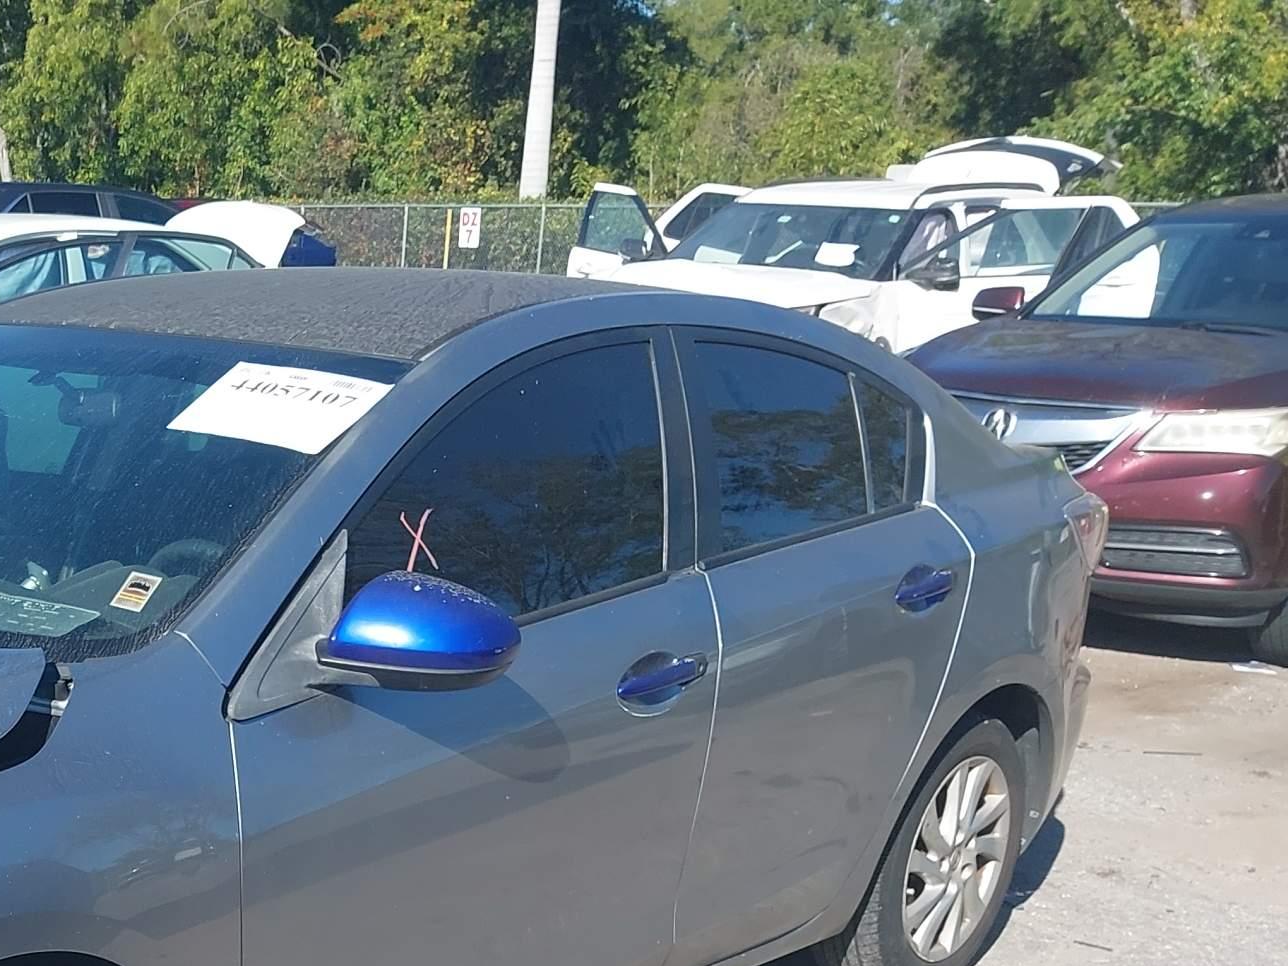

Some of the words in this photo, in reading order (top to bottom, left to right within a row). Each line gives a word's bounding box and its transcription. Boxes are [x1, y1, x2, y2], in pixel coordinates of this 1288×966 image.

[462, 212, 478, 226] DZ
[465, 229, 473, 243] 7
[231, 379, 358, 407] 44057107
